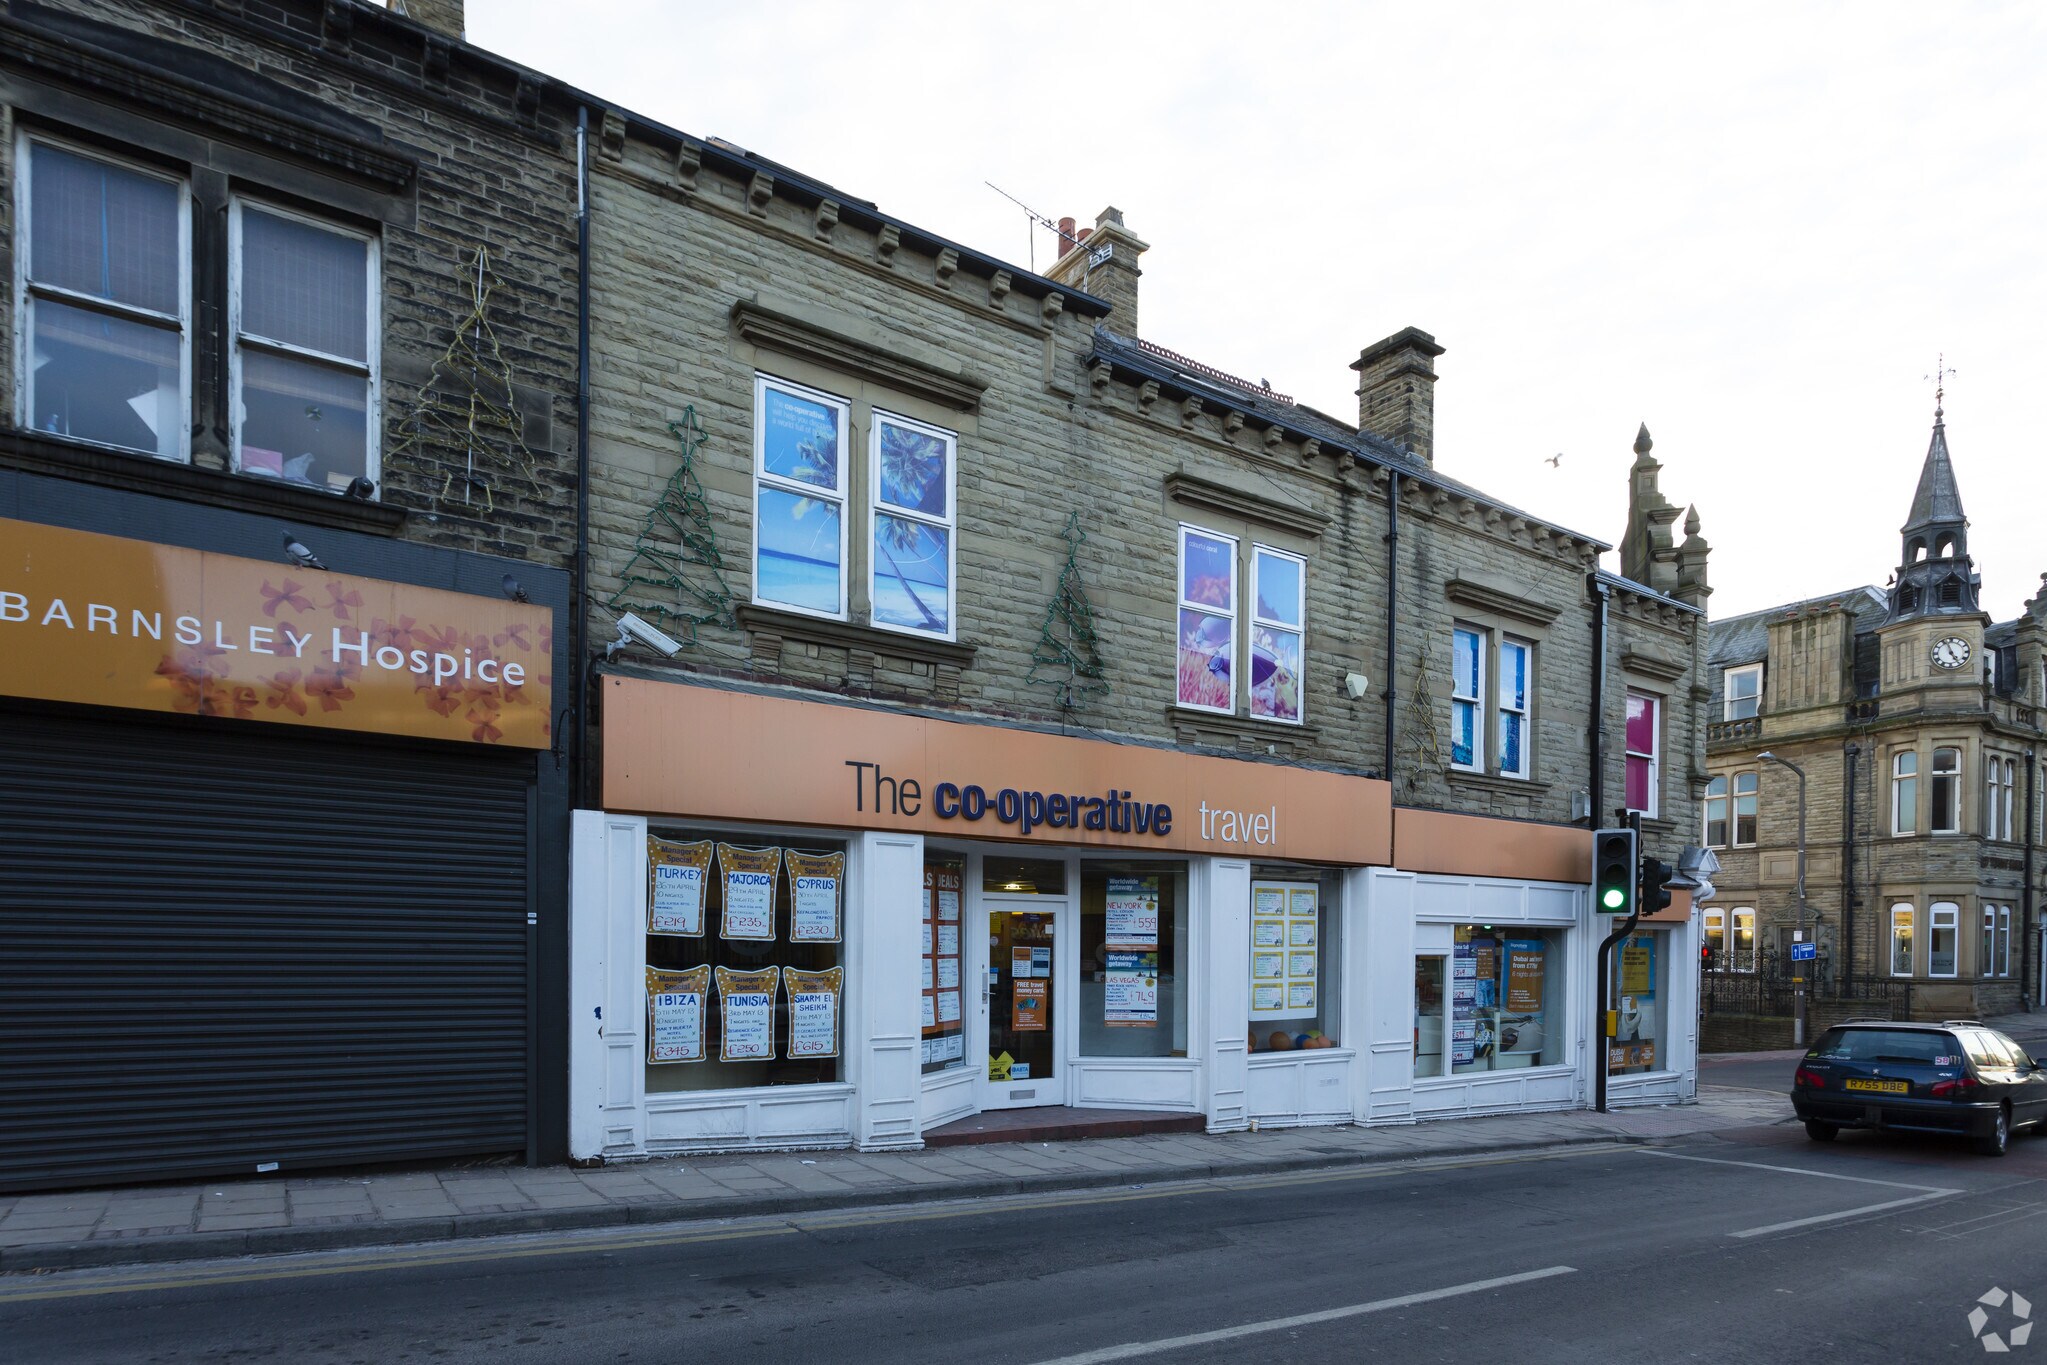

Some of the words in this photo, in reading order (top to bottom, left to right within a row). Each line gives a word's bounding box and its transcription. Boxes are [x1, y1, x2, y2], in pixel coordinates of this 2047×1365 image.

[0, 592, 312, 658] BARNSLEY
[332, 628, 526, 686] Hospice
[845, 760, 922, 817] The
[934, 781, 1172, 836] co-operative
[1198, 800, 1276, 845] travel
[661, 846, 698, 856] Manager's
[666, 854, 692, 864] Special
[732, 853, 768, 862] Manager's
[738, 862, 762, 870] Special
[800, 860, 832, 868] Manager's
[656, 868, 702, 880] TURKEY
[728, 874, 771, 886] MAJORCA
[797, 879, 834, 890] CYPRUS
[653, 916, 686, 928] £219
[728, 916, 762, 928] £235
[1133, 917, 1156, 928] £559
[797, 926, 829, 936] £230
[659, 995, 696, 1006] IBIZA
[727, 996, 769, 1006] TUNISIA
[794, 994, 820, 1003] SHARM
[794, 1041, 824, 1052] £615
[1850, 1080, 1879, 1090] R755
